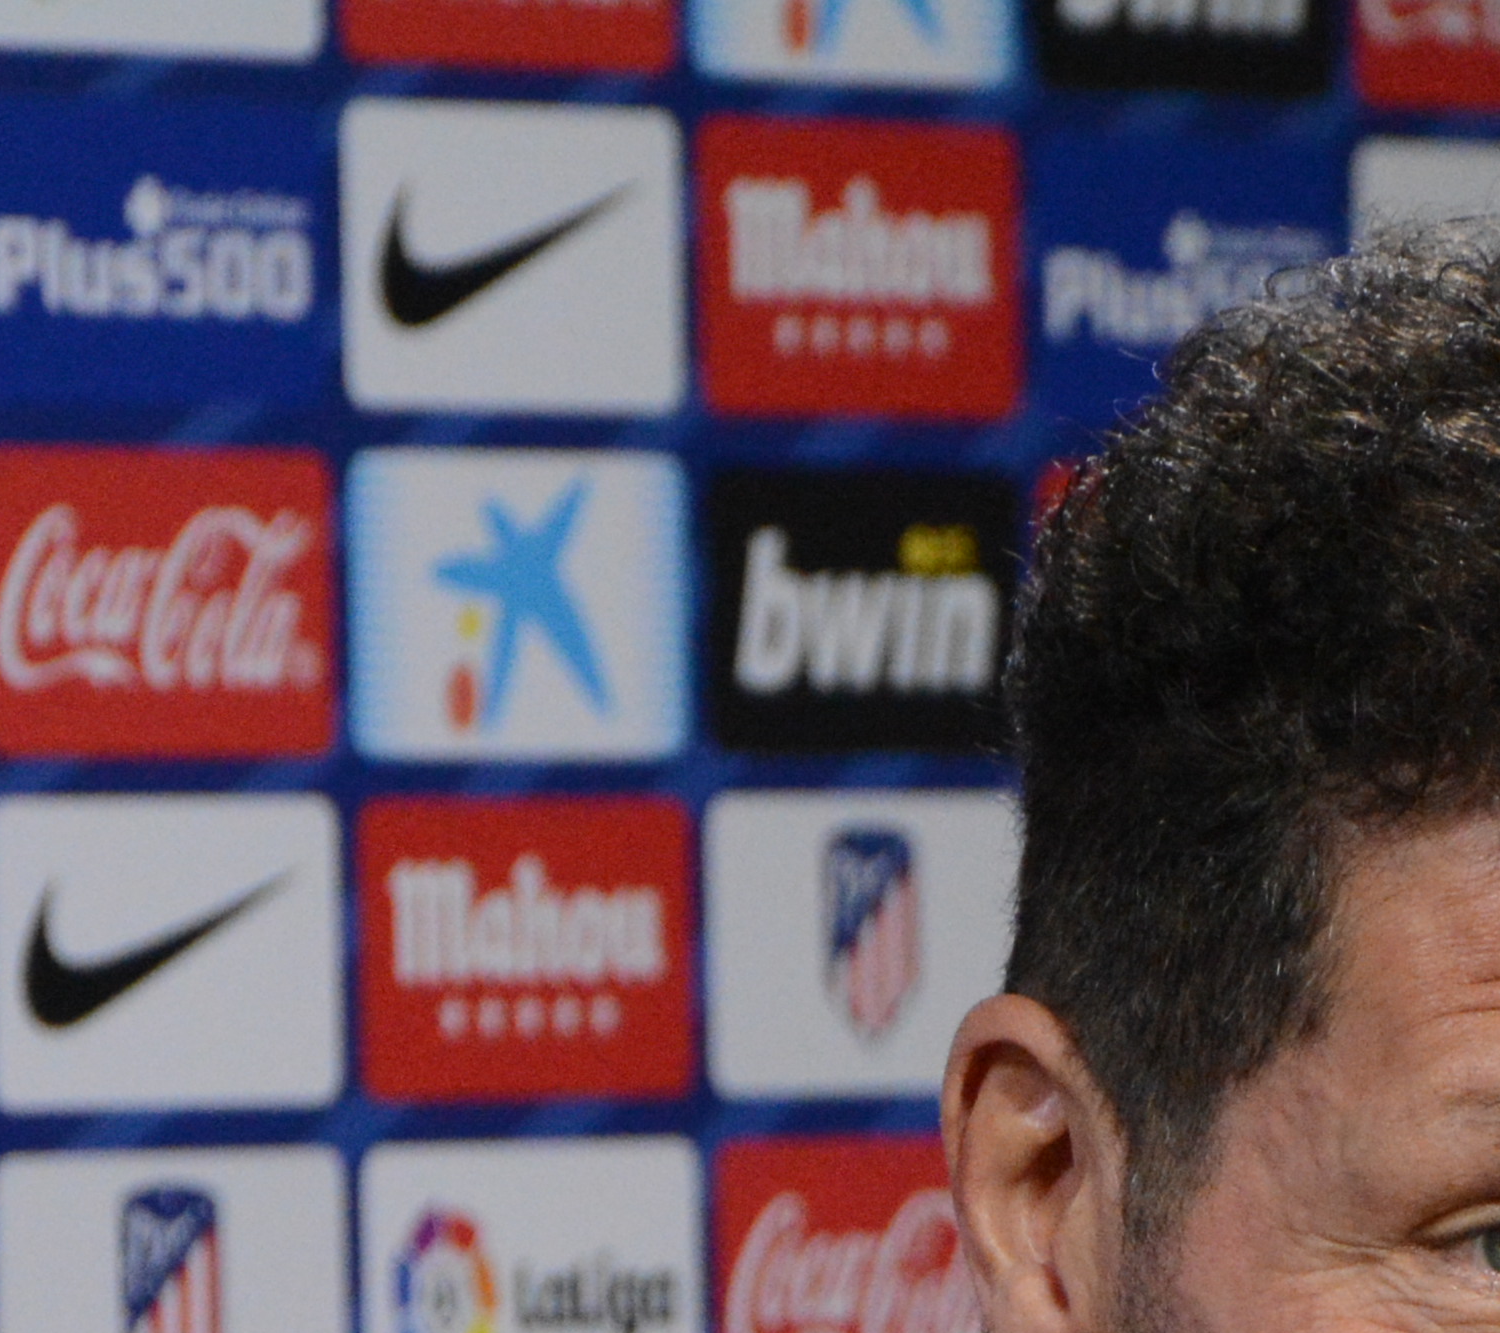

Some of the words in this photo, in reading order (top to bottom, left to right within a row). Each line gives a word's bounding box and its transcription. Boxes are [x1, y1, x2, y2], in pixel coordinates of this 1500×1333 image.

[725, 178, 992, 304] Mahou
[736, 530, 995, 691] bwin
[389, 856, 665, 984] Mahou
